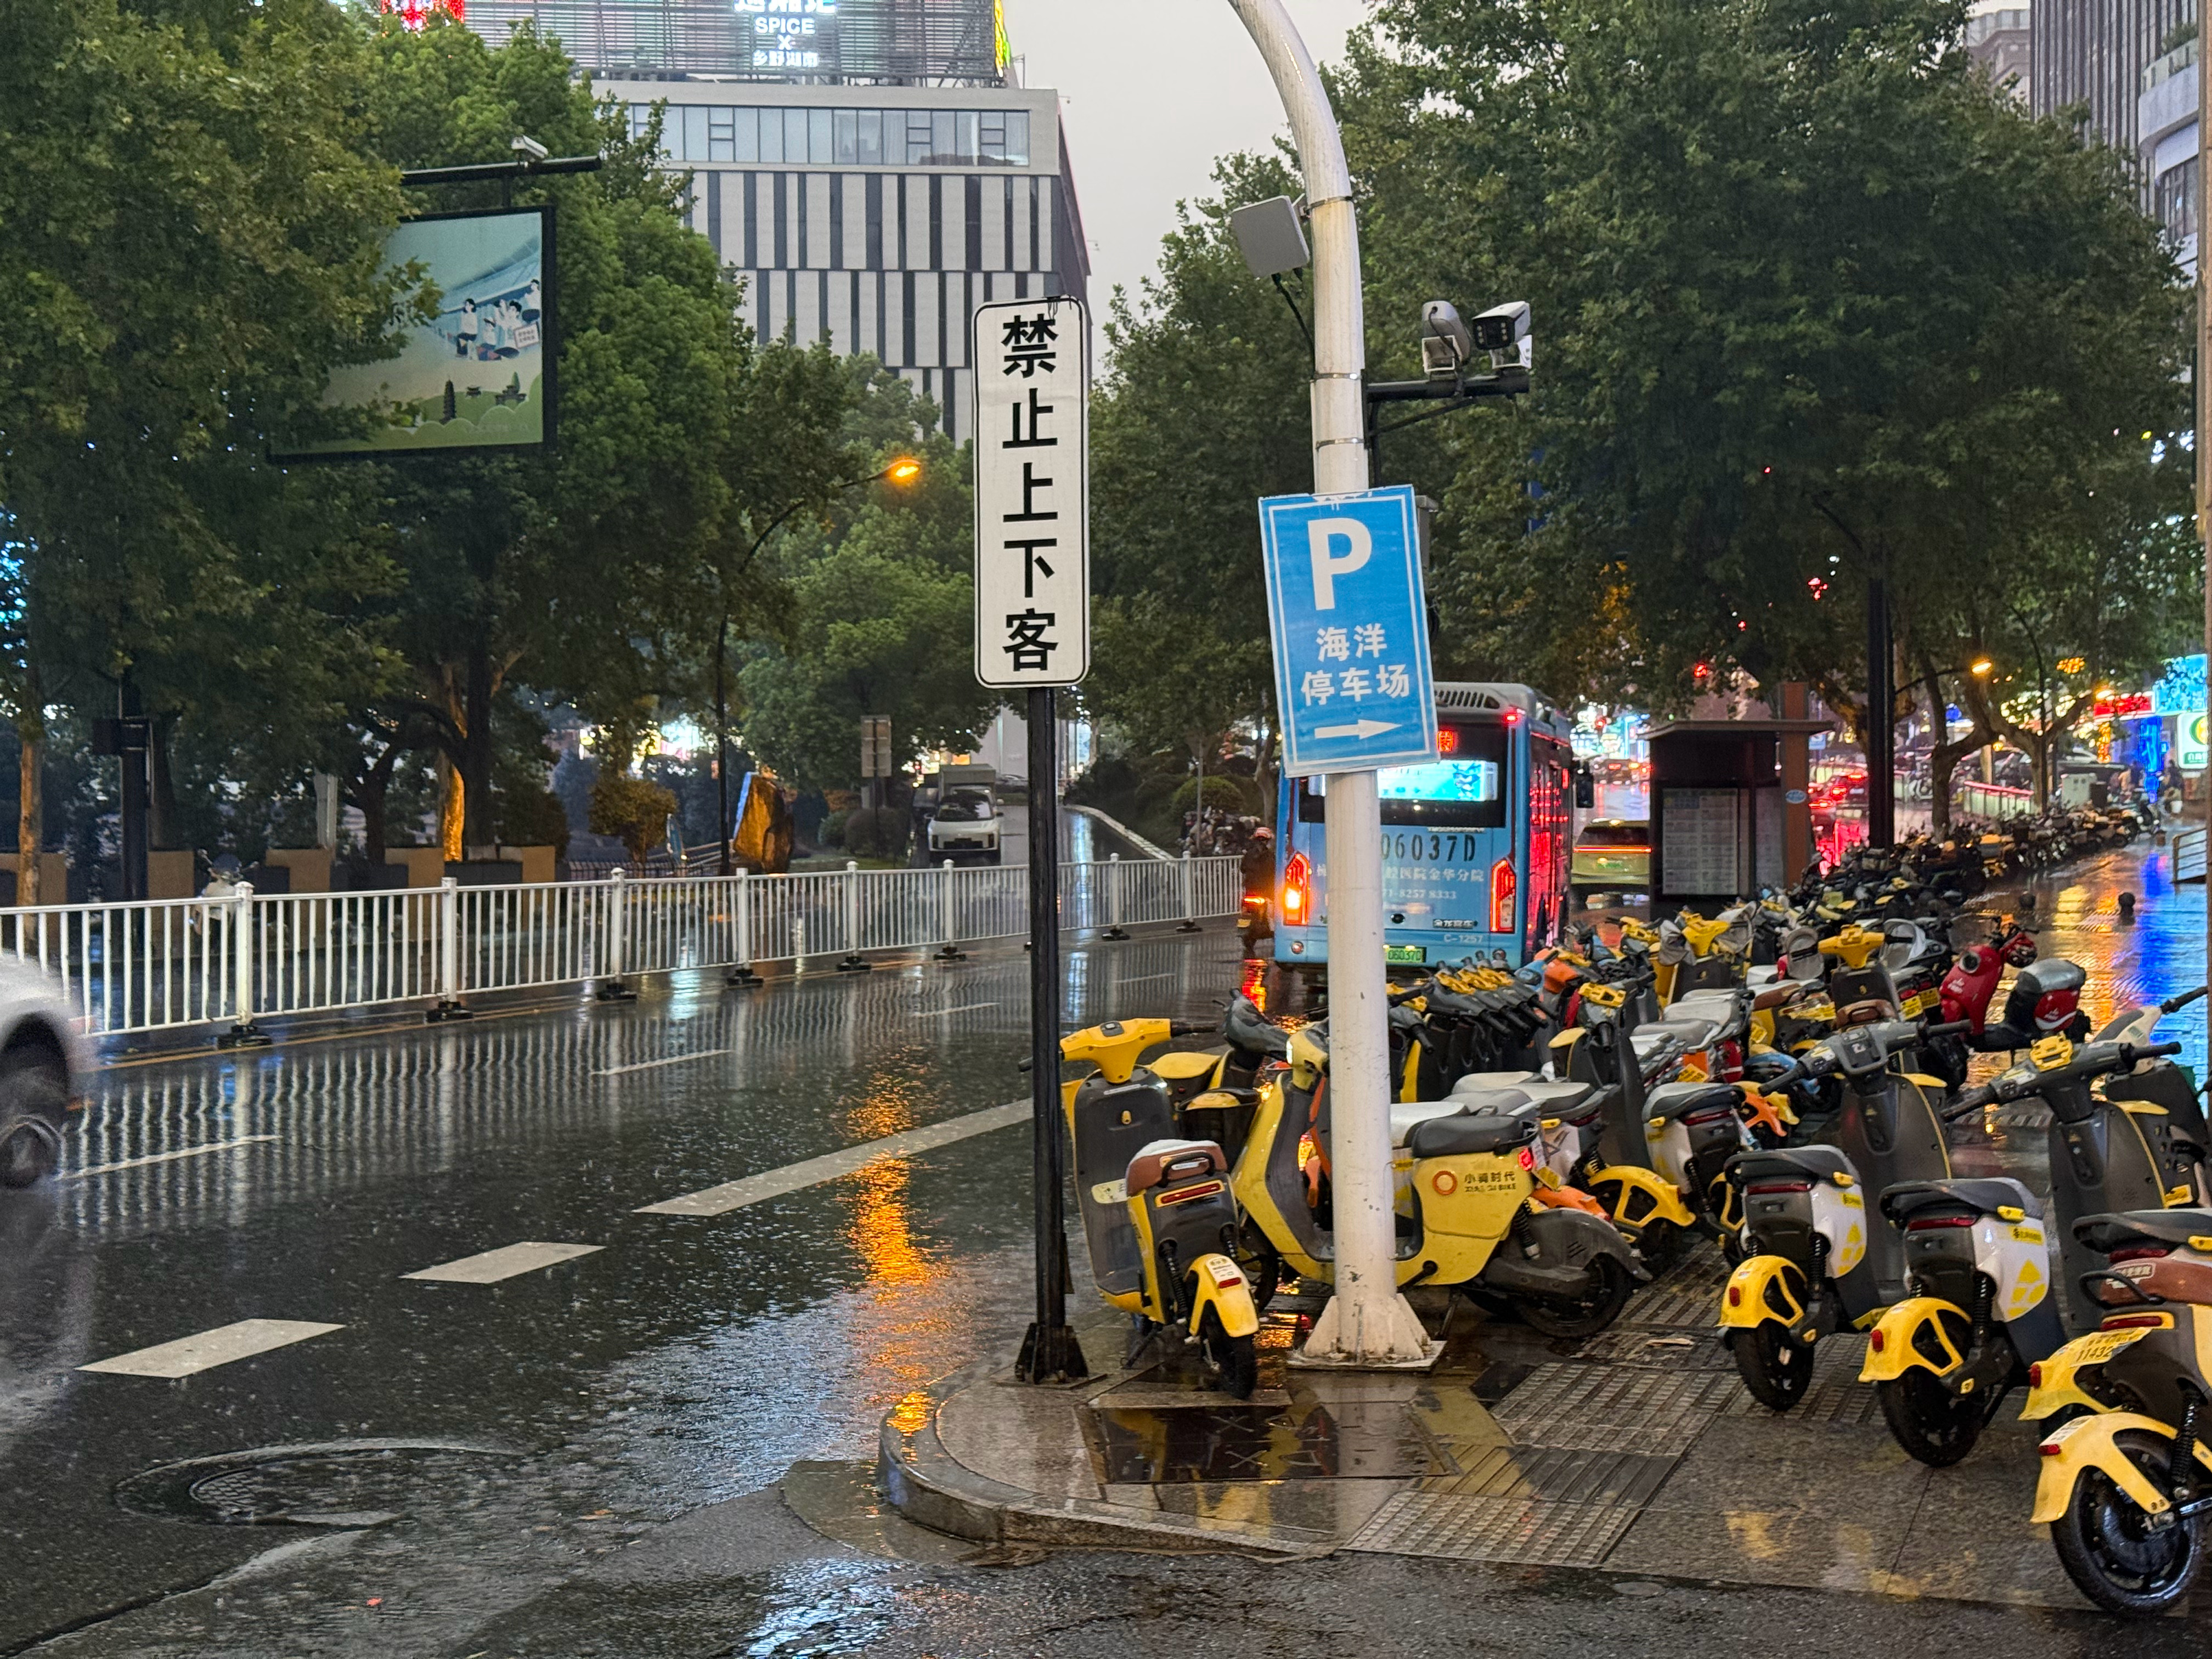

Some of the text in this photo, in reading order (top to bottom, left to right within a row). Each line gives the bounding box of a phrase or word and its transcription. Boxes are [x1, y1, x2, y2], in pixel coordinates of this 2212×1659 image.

[754, 17, 816, 34] SPICE
[1001, 313, 1059, 672] 禁止上下客
[1307, 517, 1372, 611] P
[1316, 623, 1387, 662] 海洋
[1300, 663, 1410, 707] 停车场
[1380, 833, 1476, 862] 06037D
[1443, 933, 1483, 943] C-1257
